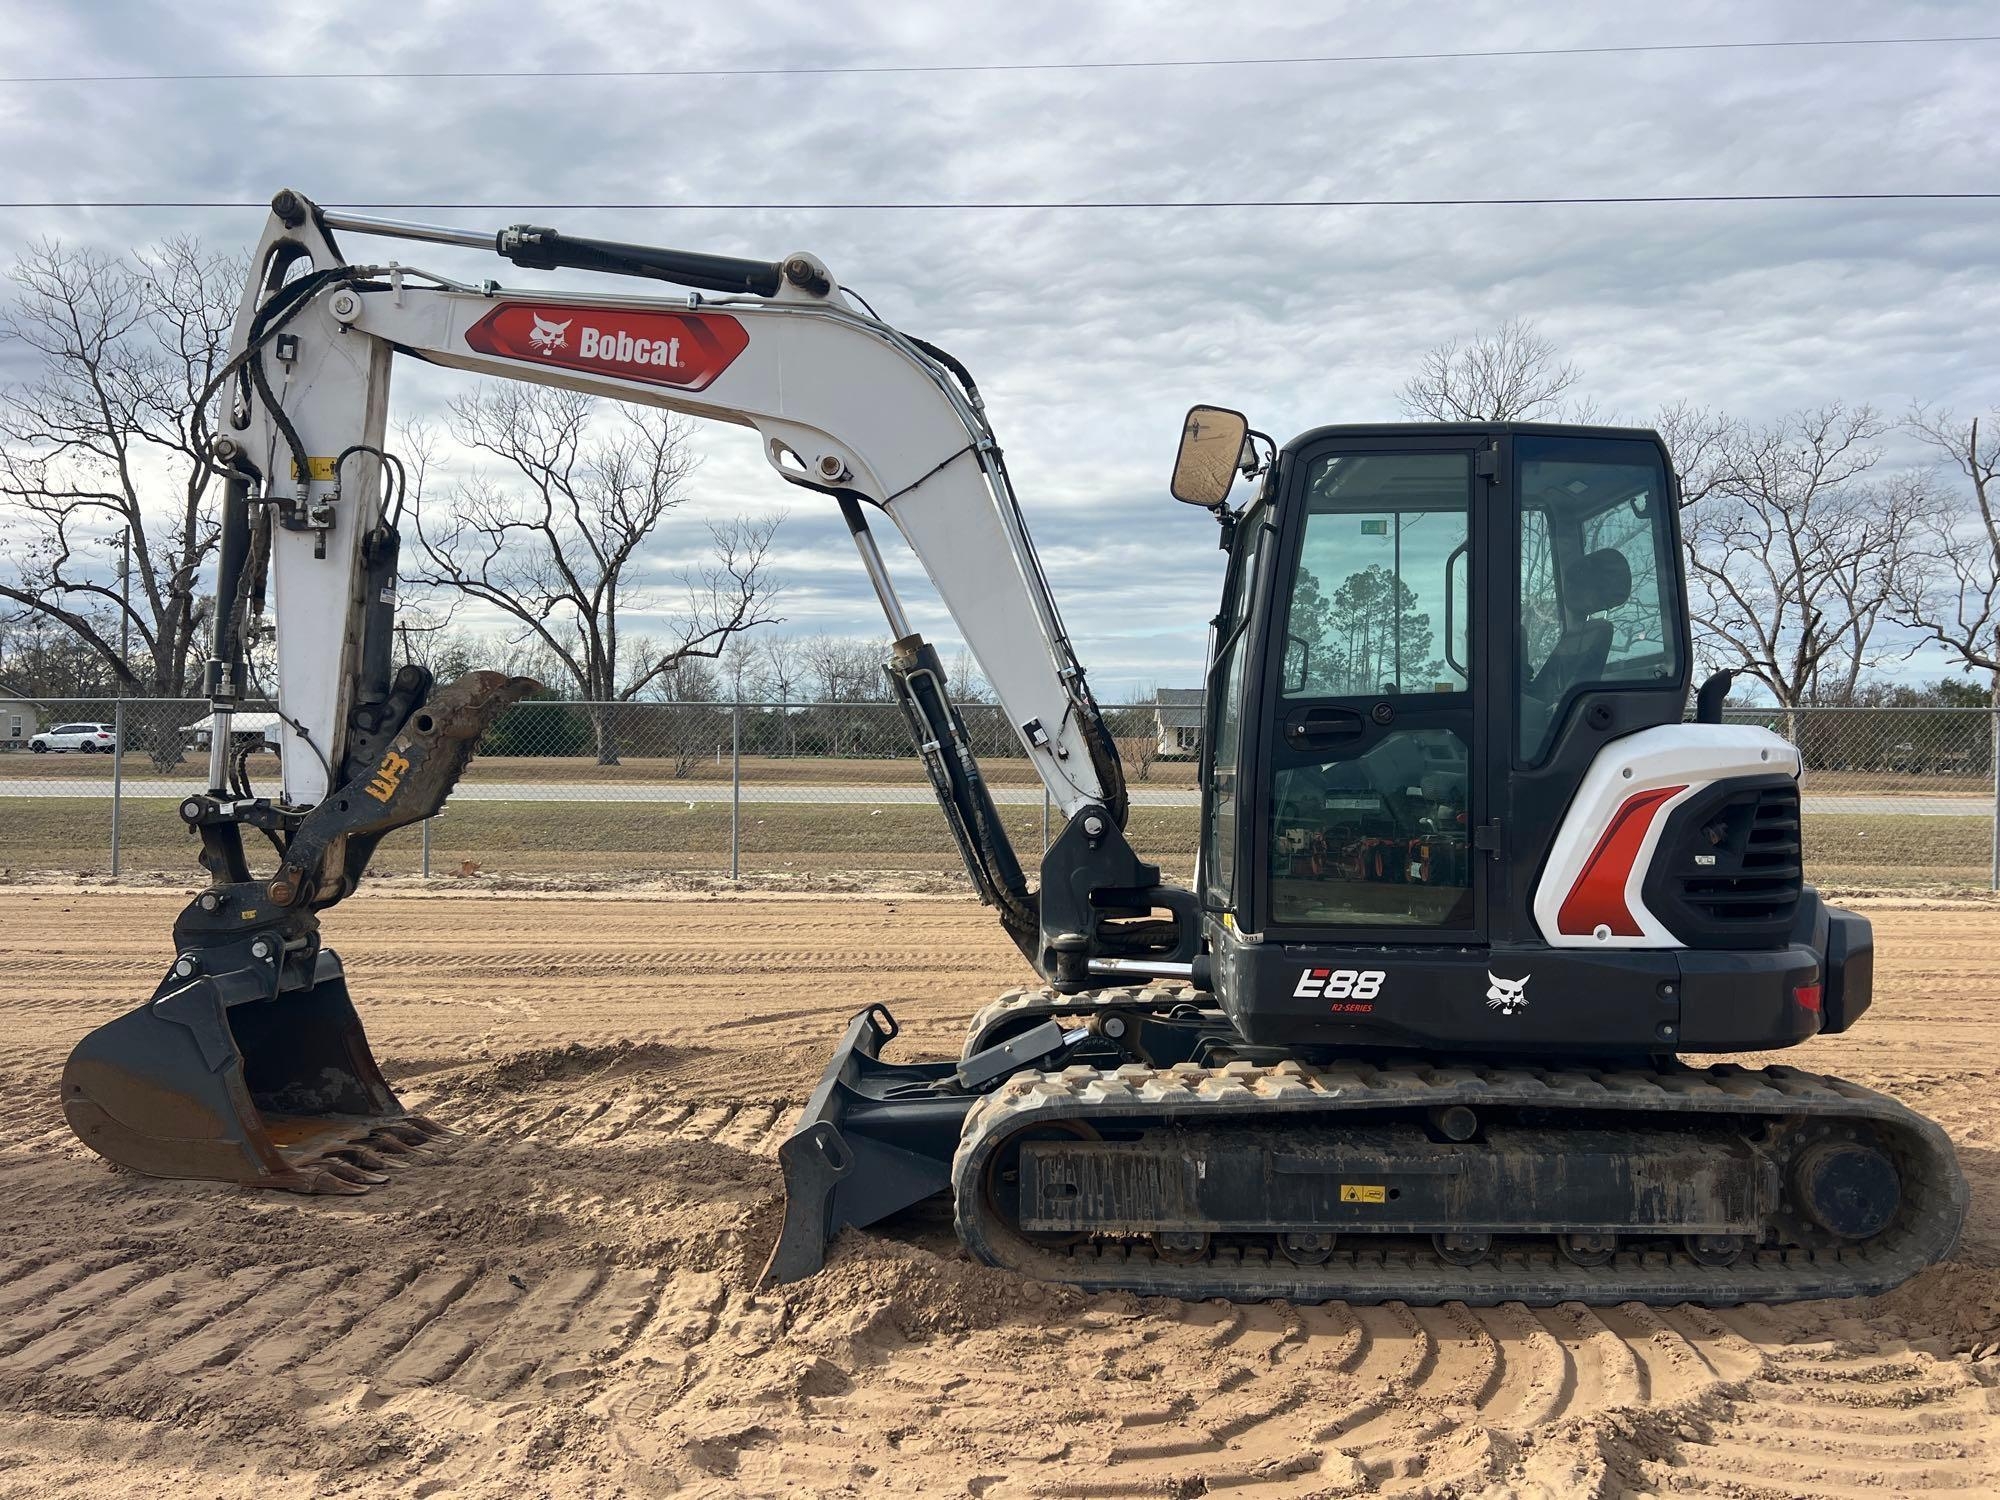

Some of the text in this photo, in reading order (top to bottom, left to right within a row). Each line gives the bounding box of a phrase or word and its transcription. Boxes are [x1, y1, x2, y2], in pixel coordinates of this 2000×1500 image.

[580, 327, 680, 367] Bobcat
[1292, 968, 1387, 999] E88
[1331, 1003, 1373, 1012] R2-SERIES
